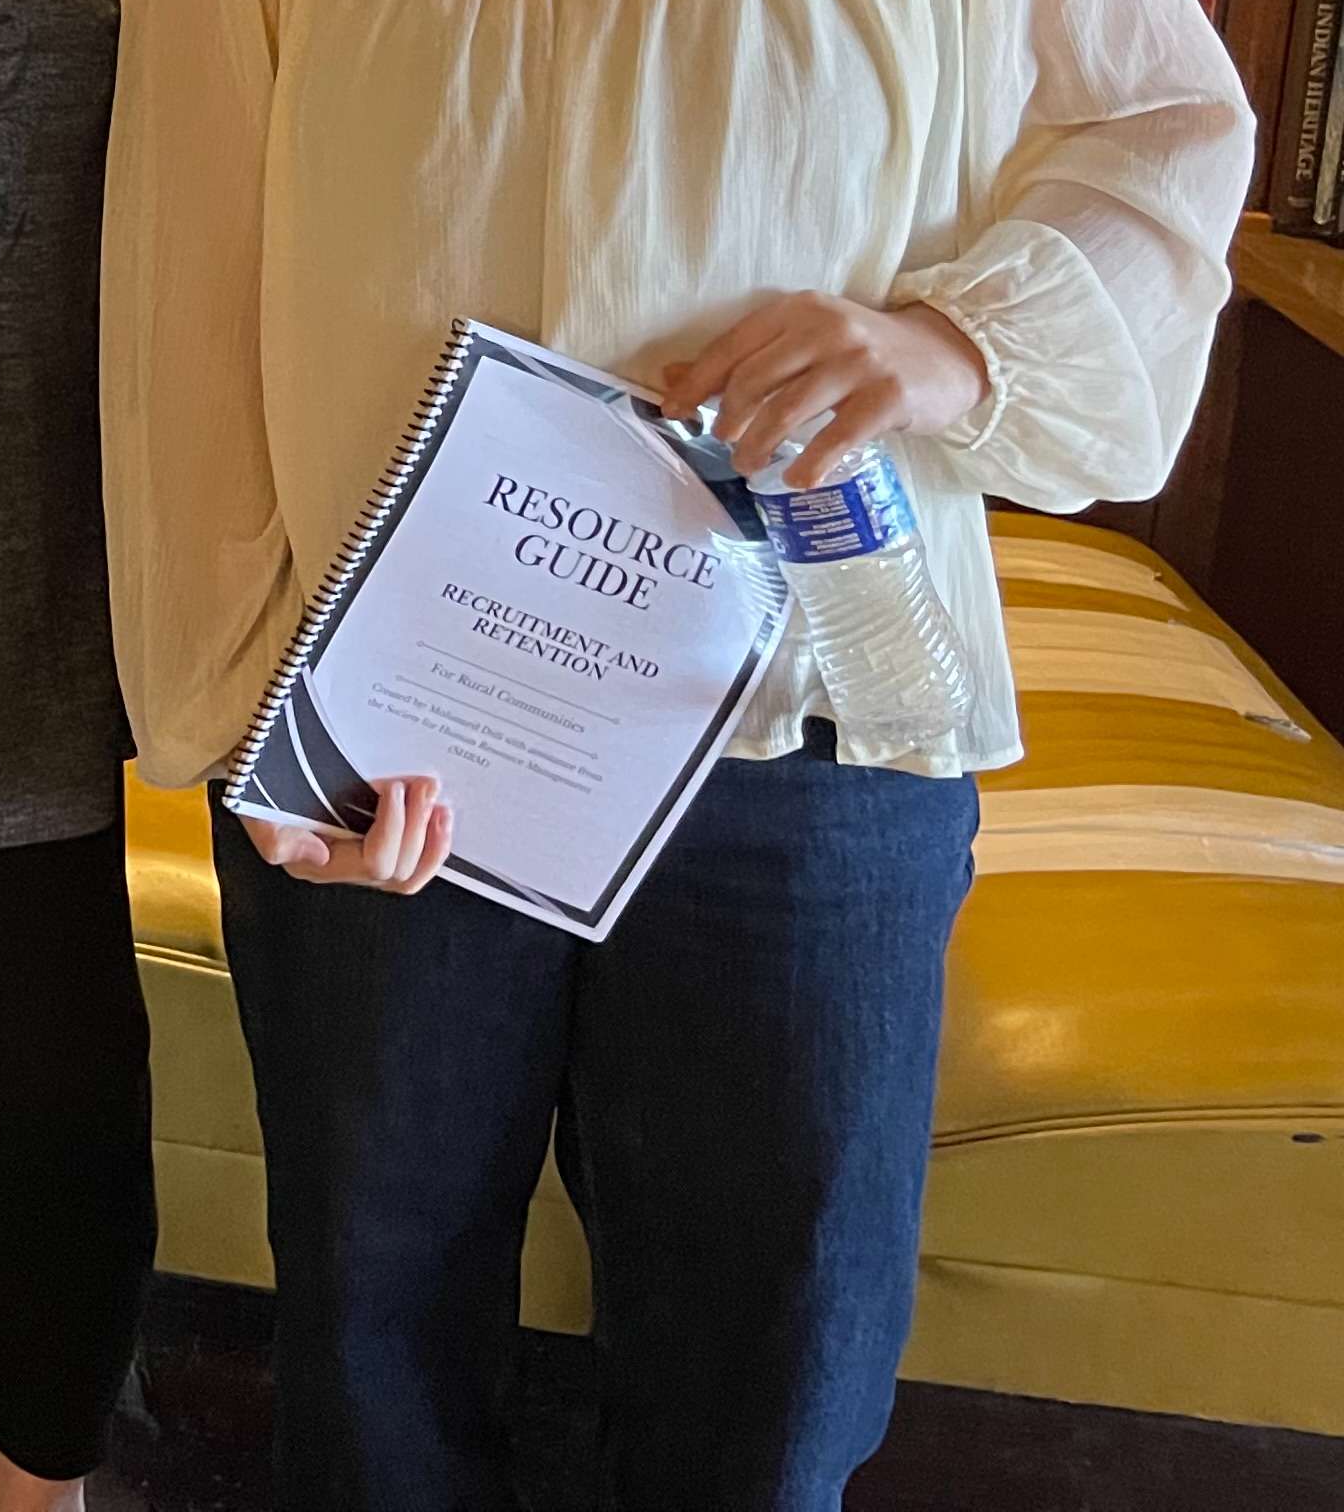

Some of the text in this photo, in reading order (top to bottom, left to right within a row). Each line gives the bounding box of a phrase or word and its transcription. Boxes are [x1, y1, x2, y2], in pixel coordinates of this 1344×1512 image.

[1309, 2, 1335, 78] INDIAN
[1295, 80, 1325, 182] HERITAGE
[483, 472, 721, 590] RESOURCE
[514, 534, 658, 611] GUIDE
[440, 582, 659, 680] RECRUITMENT AND
[472, 617, 610, 681] RETENTION
[430, 663, 455, 680] For
[457, 672, 497, 697] Rural
[497, 688, 585, 735] Communities
